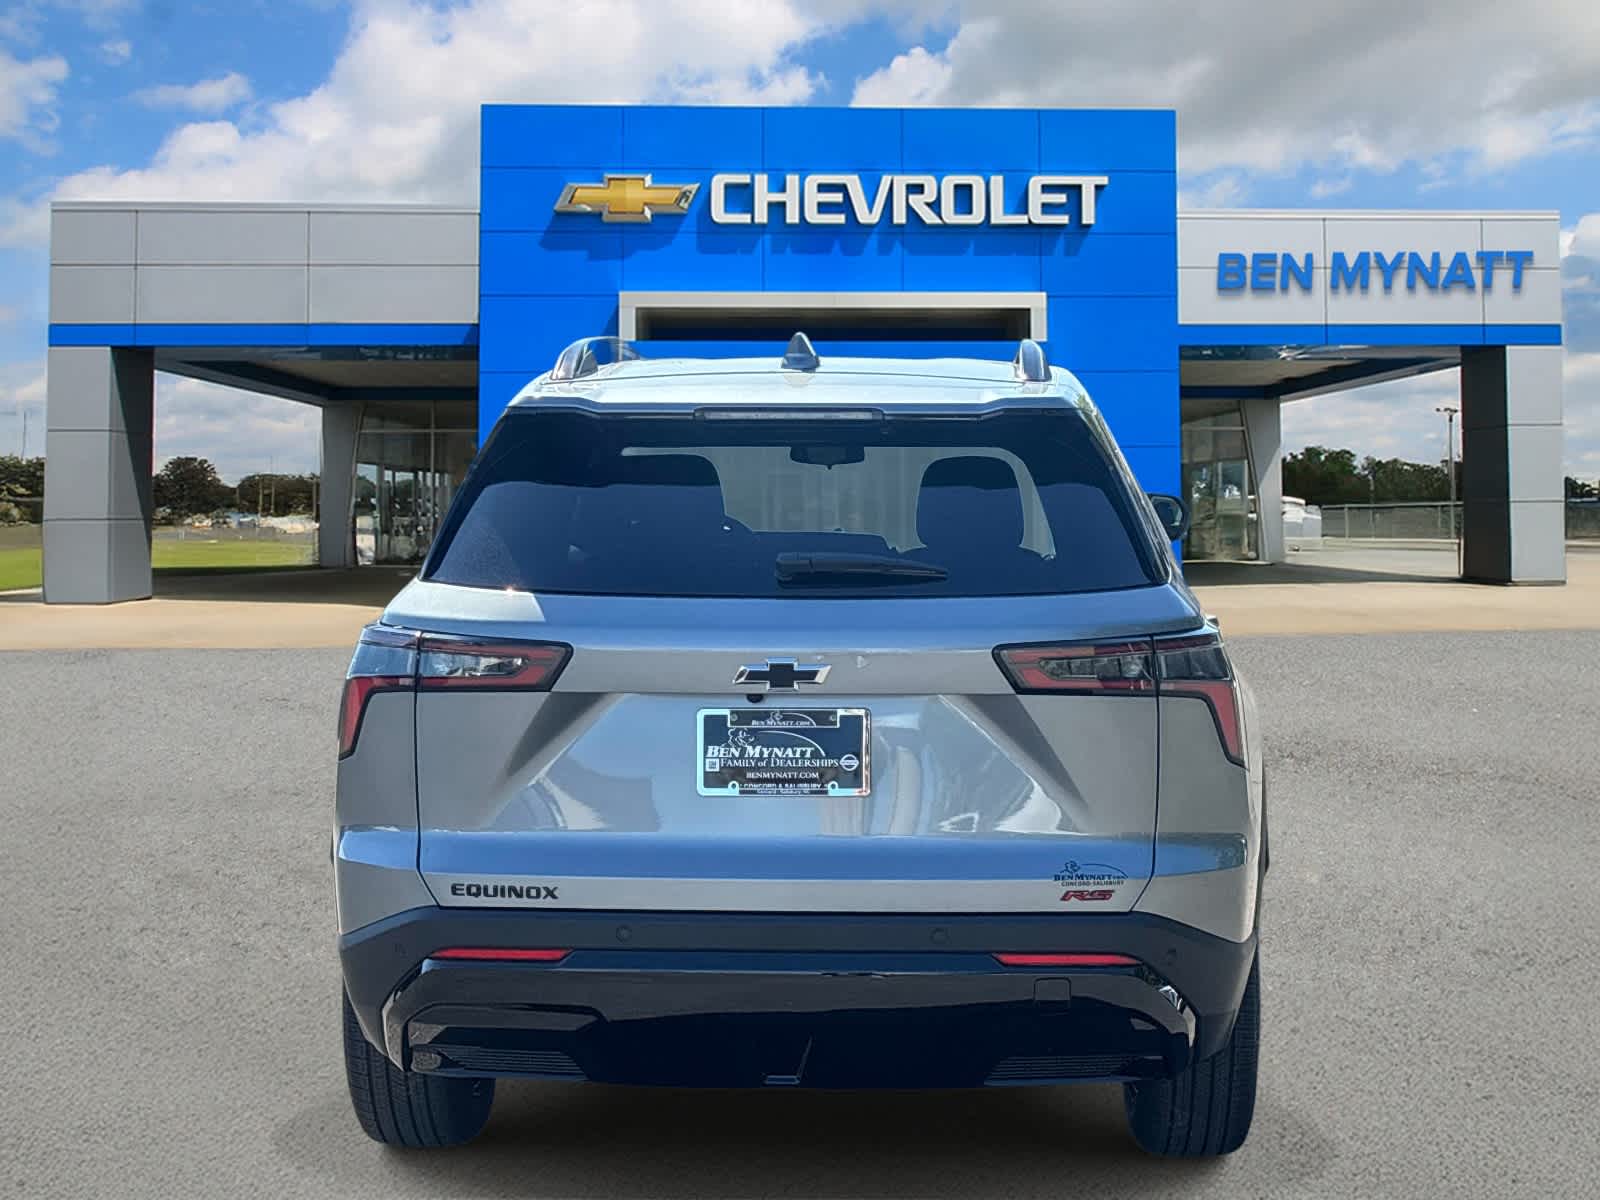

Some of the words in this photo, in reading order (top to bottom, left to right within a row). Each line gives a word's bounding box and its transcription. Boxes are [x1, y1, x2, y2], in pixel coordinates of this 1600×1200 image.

[710, 173, 1109, 225] CHEVROLET
[1217, 252, 1313, 291] BEN
[1330, 250, 1534, 291] MYNATT
[706, 745, 741, 758] BEN
[744, 745, 815, 758] MYNATT
[720, 758, 755, 767] FAMILY
[757, 759, 767, 767] of
[770, 758, 839, 768] DEALERSHIPS
[450, 883, 559, 899] EQUINOX
[1060, 889, 1115, 901] RS
